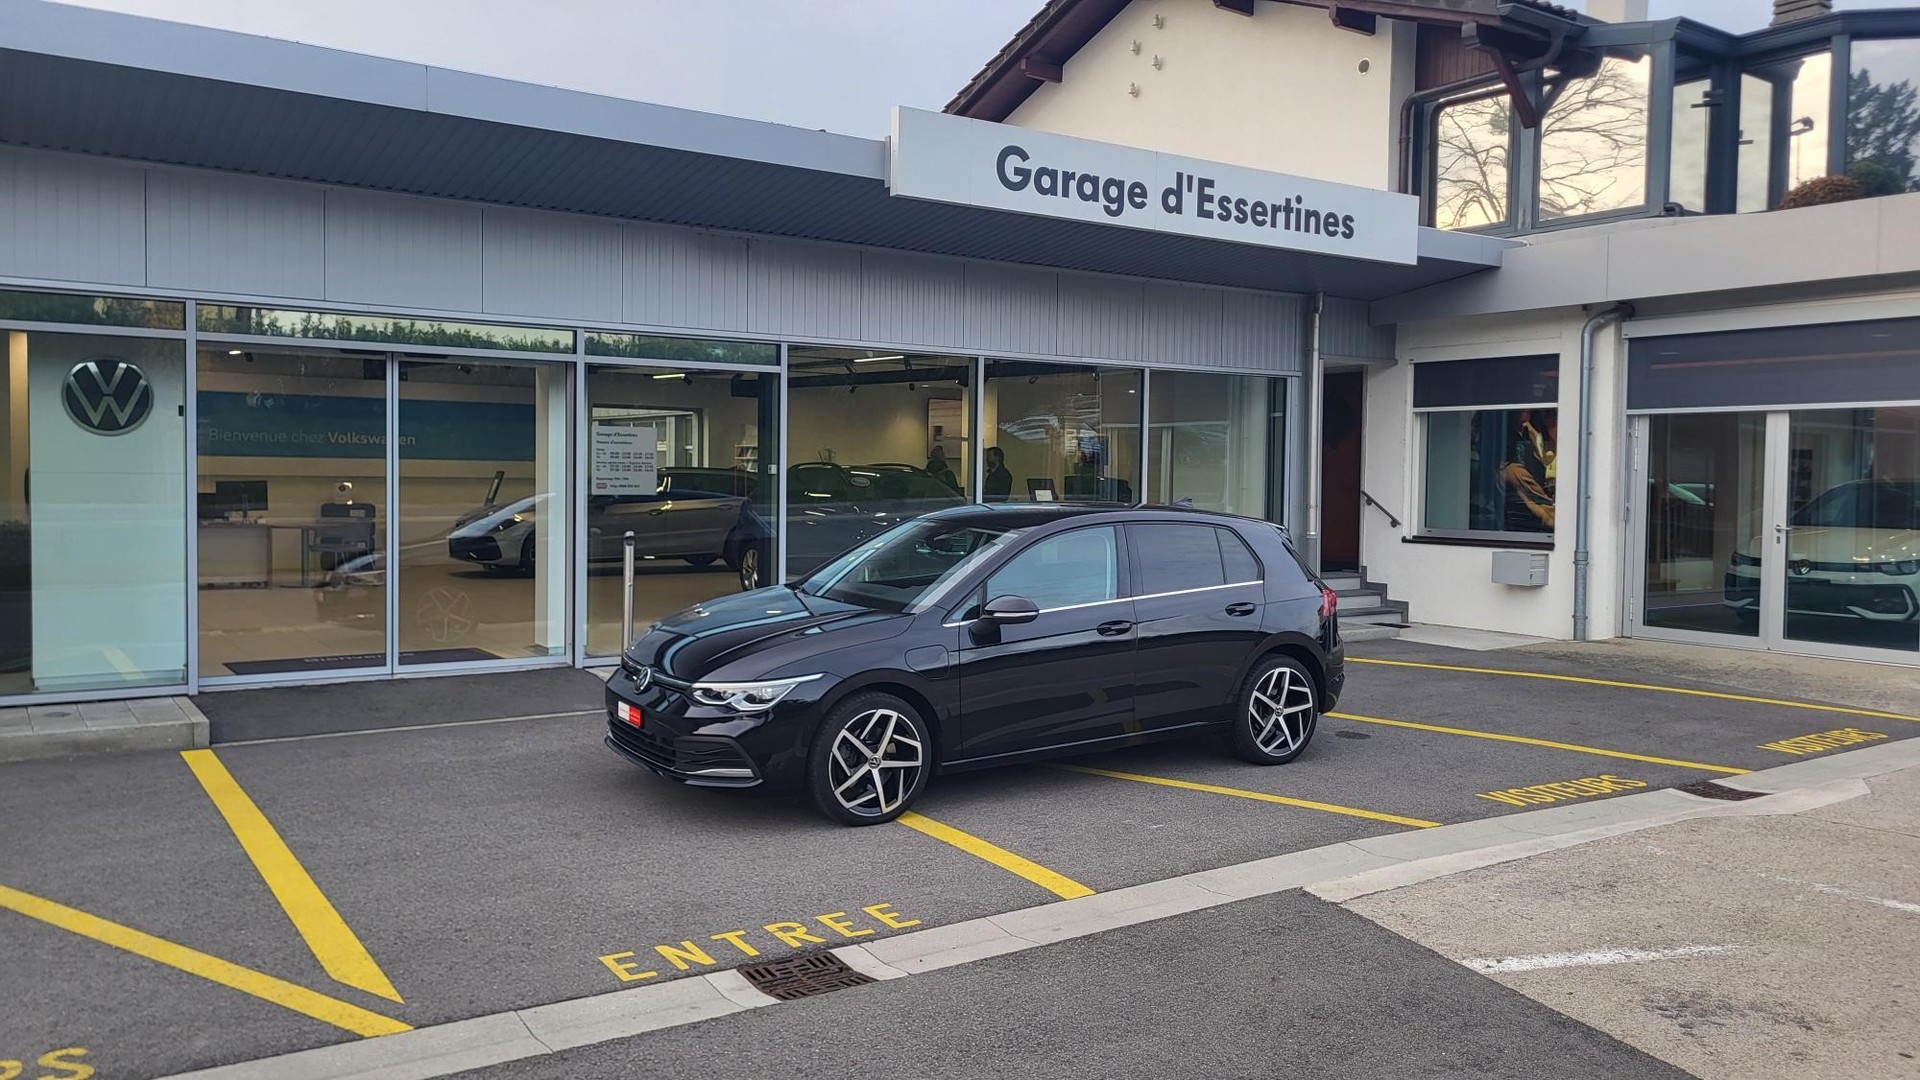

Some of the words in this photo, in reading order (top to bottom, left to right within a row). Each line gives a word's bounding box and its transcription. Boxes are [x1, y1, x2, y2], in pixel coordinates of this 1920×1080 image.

[996, 145, 1148, 218] Garage
[1161, 171, 1355, 240] d'Essertines
[208, 427, 286, 442] Bienvenue
[291, 430, 325, 444] chez
[327, 431, 416, 445] Volkswaen
[1755, 727, 1889, 755] VISITEURS
[1475, 774, 1648, 807] VISITEURS
[598, 902, 922, 982] ENTREE
